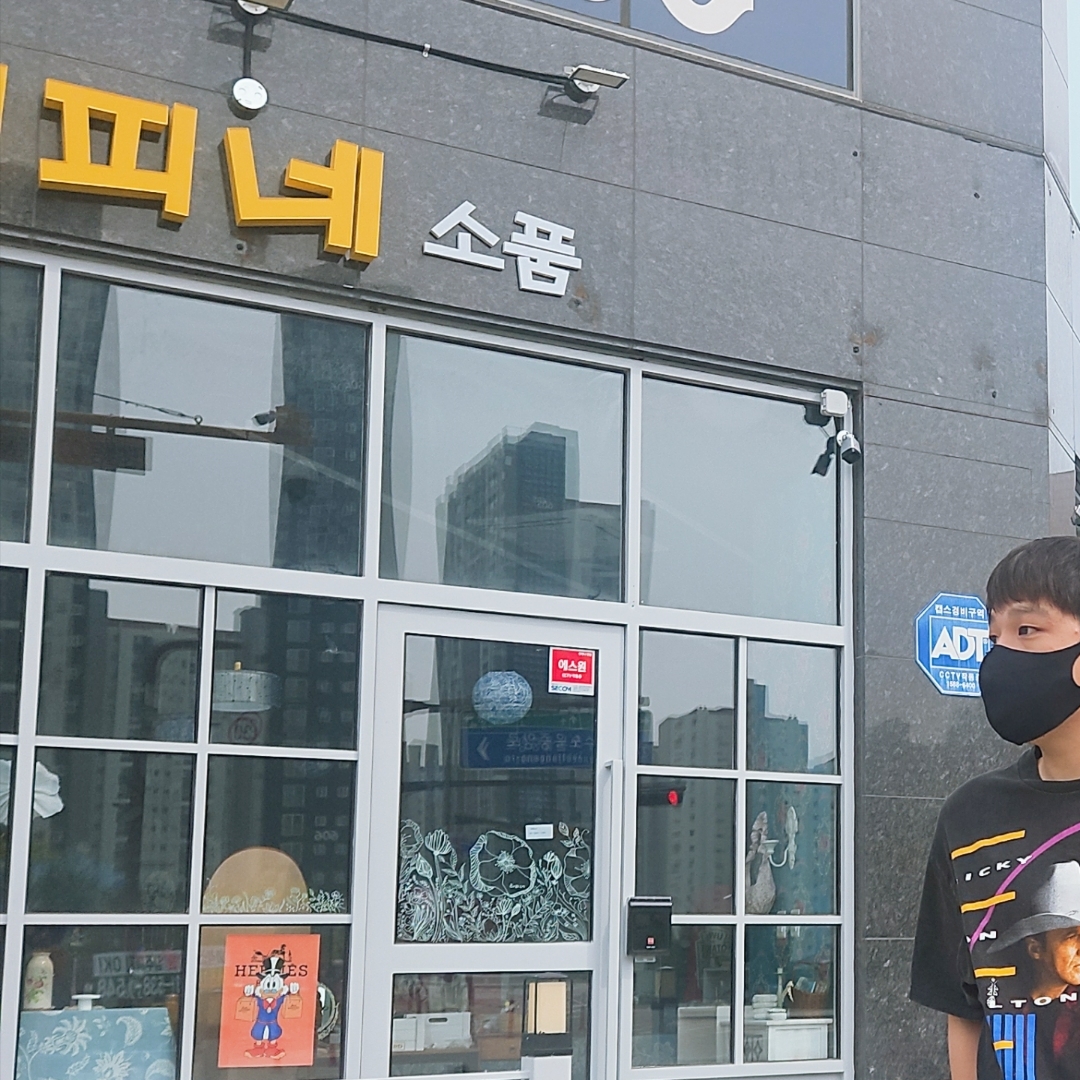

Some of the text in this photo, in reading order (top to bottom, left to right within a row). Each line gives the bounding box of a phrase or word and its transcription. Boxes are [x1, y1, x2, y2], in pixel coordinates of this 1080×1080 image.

[0, 64, 583, 297] 피네 소품
[934, 604, 985, 619] 캡스경비구역
[931, 626, 989, 662] ADT
[557, 659, 587, 673] 에스원
[955, 855, 1034, 884] ICKY
